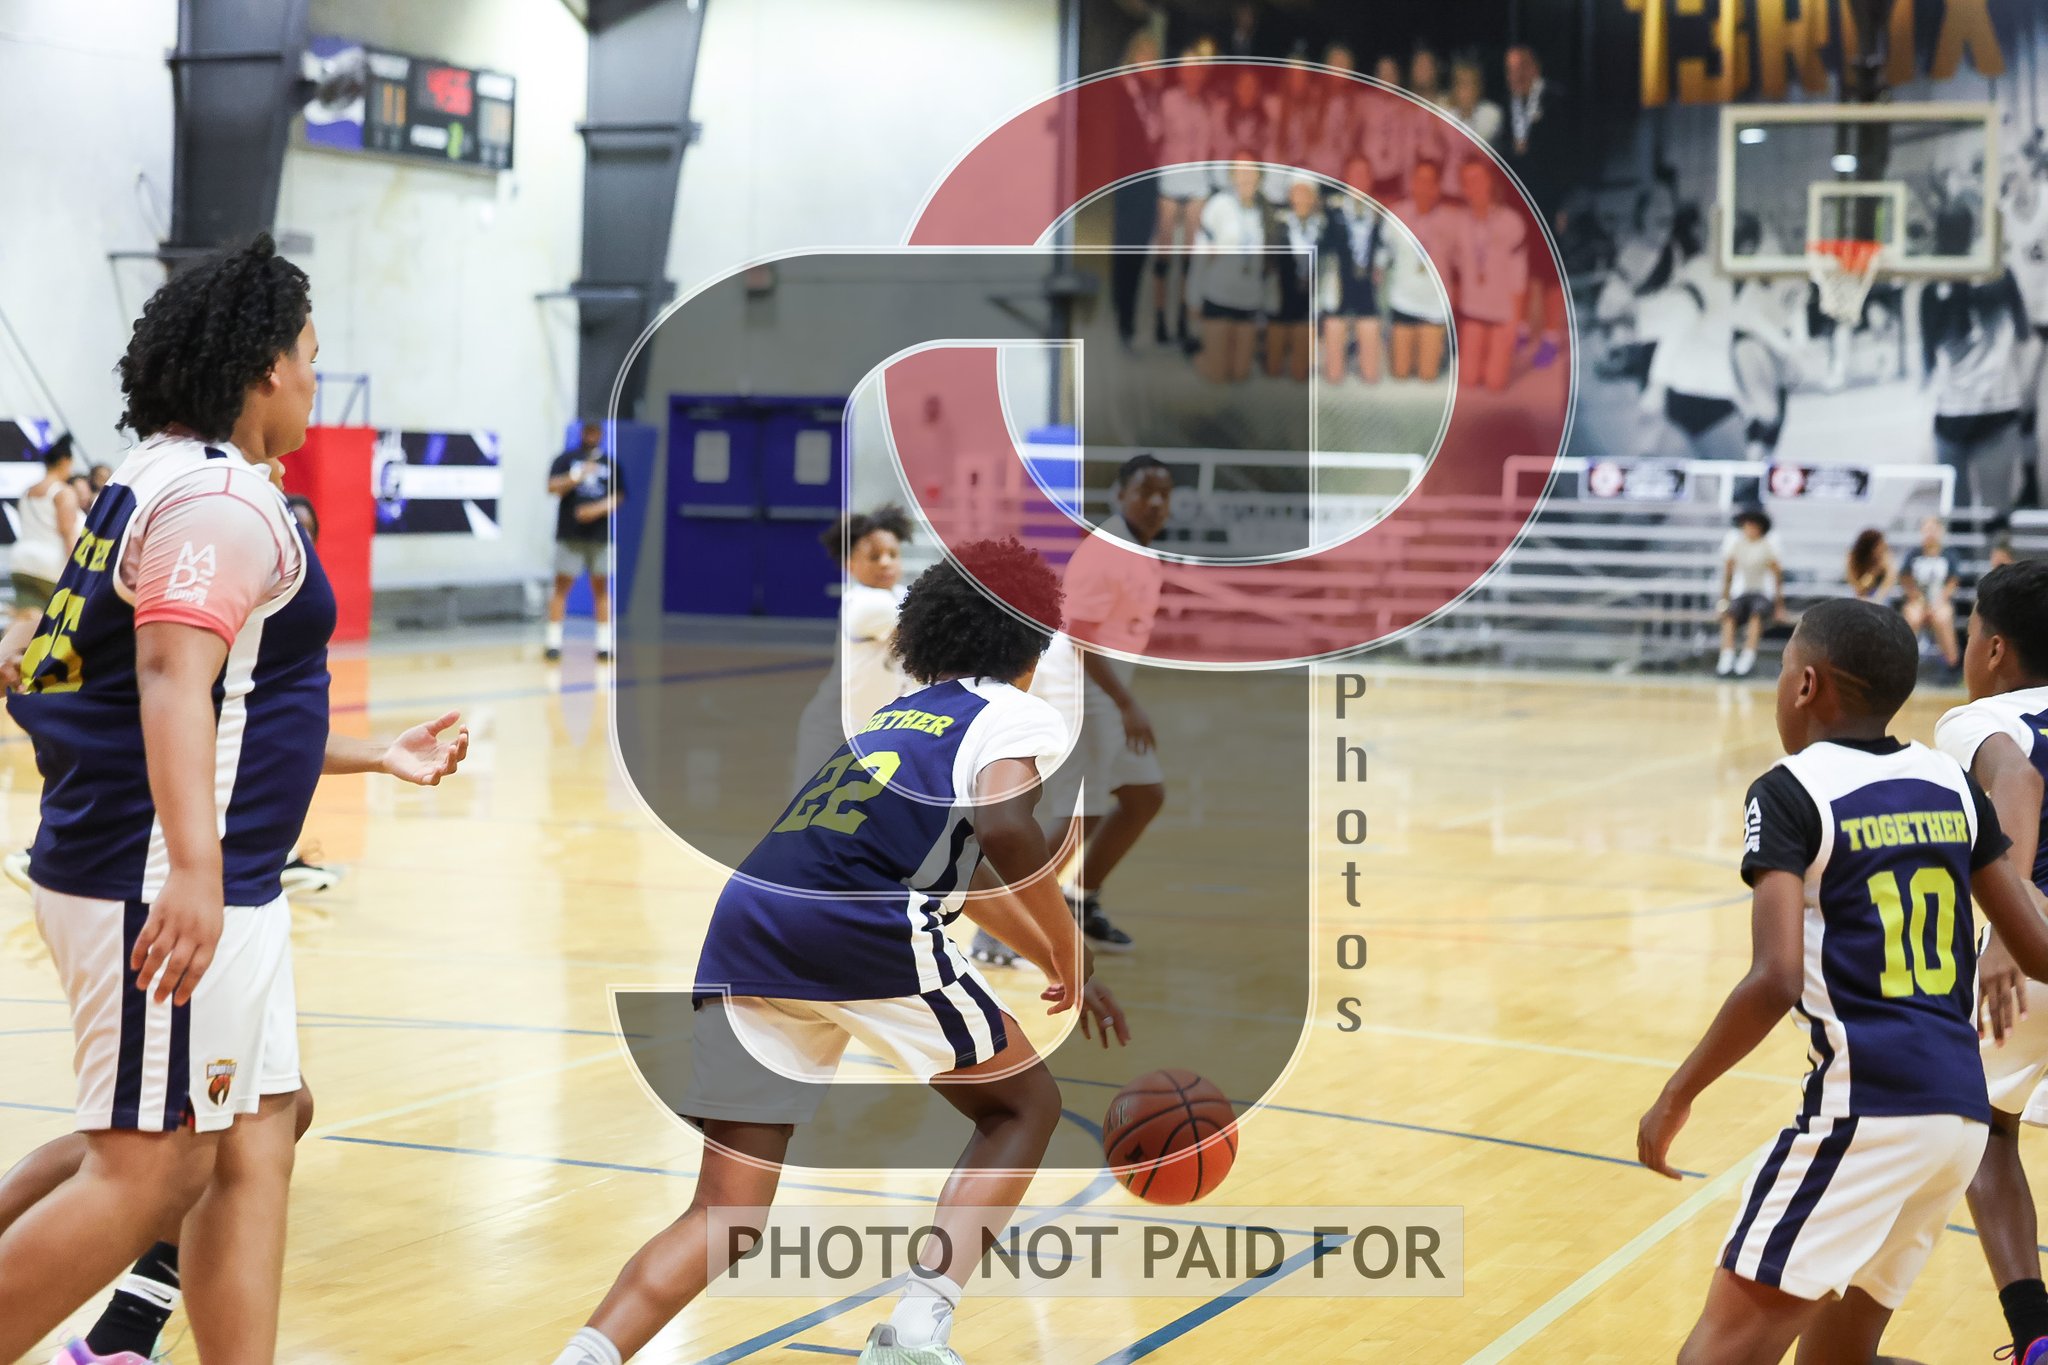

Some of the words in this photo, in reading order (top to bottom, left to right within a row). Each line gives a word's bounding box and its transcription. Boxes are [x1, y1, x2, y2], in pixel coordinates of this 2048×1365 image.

[857, 709, 955, 737] GETHER
[773, 751, 902, 835] 22
[1840, 811, 1968, 852] TOGETHER
[1867, 867, 1956, 998] 10
